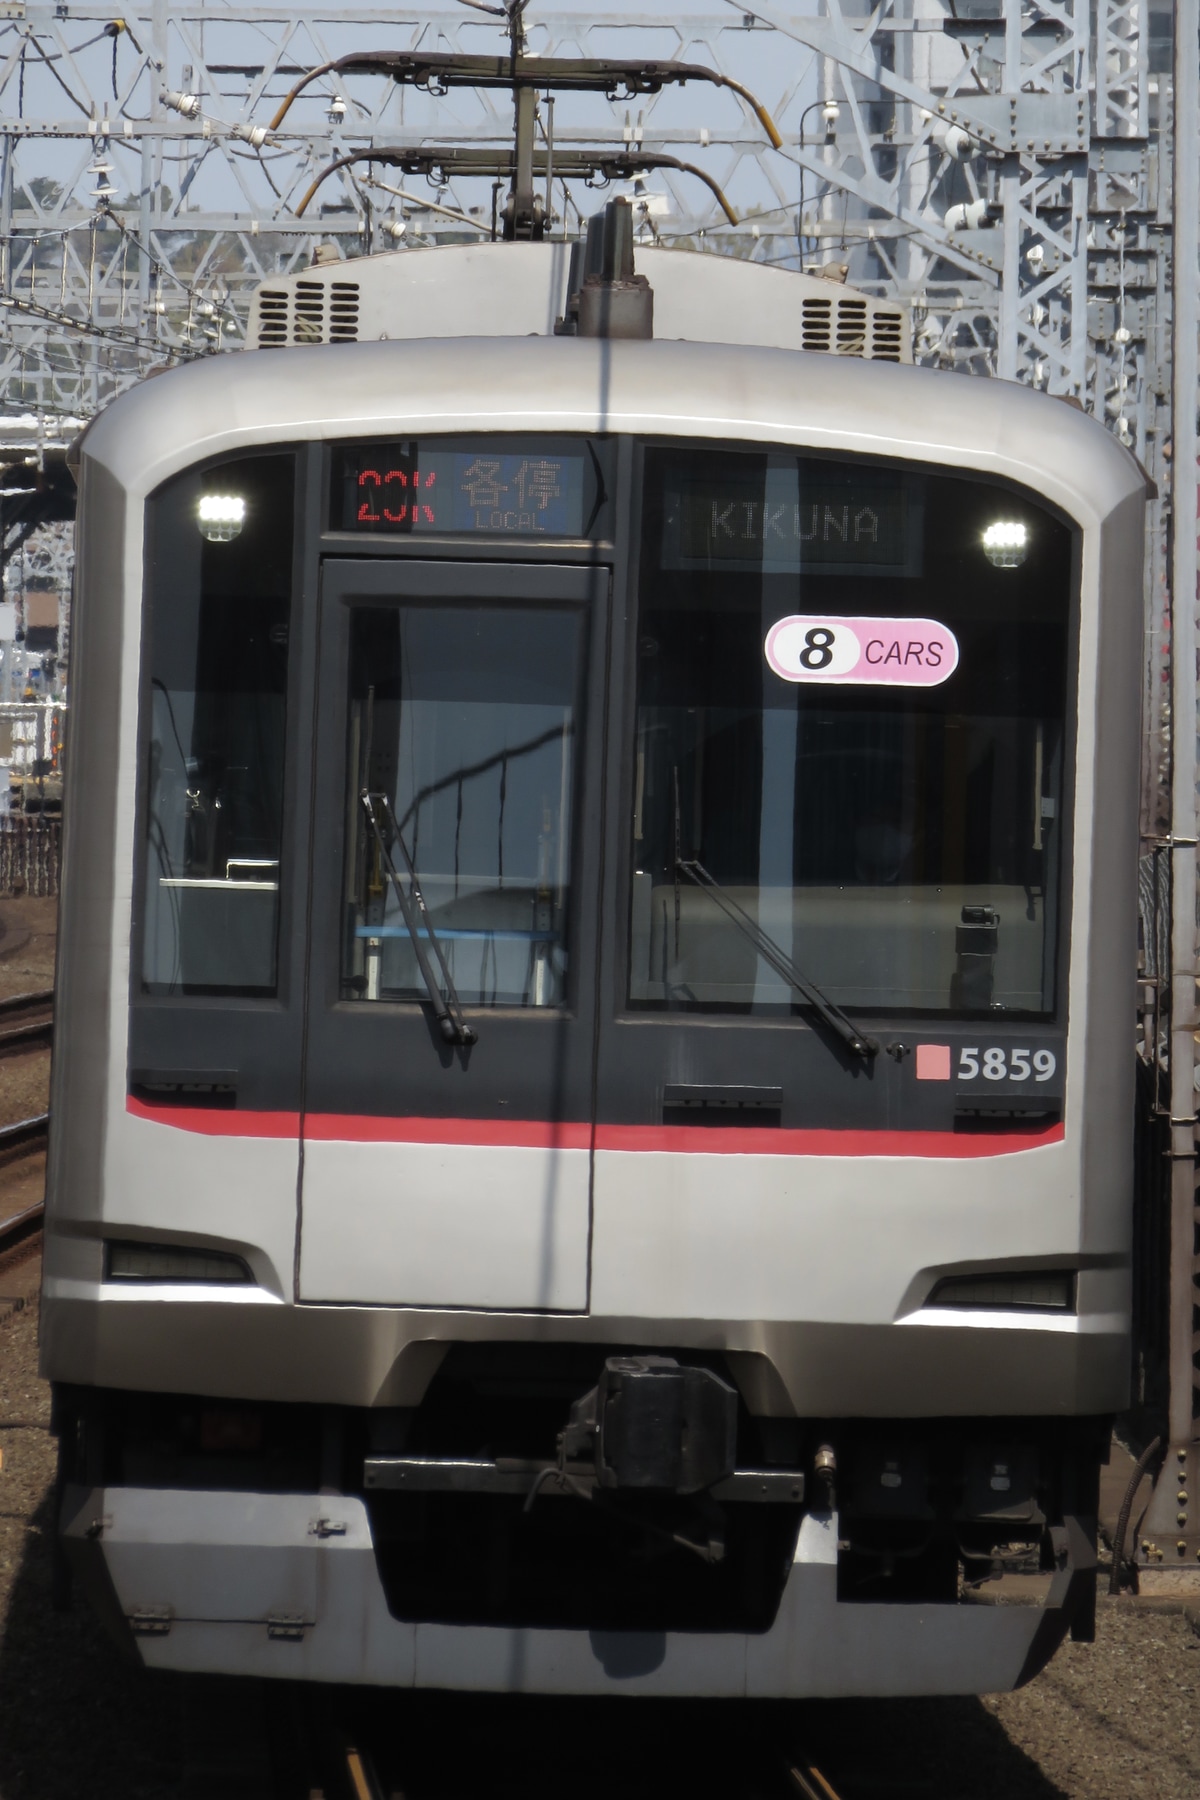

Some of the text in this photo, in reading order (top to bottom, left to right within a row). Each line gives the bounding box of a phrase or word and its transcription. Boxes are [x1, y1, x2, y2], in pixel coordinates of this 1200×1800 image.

[461, 459, 561, 510] 各停
[474, 510, 545, 531] LOCAL
[711, 501, 879, 542] KIKUNA
[799, 627, 944, 670] 8 CARS
[957, 1047, 1057, 1082] 5859
